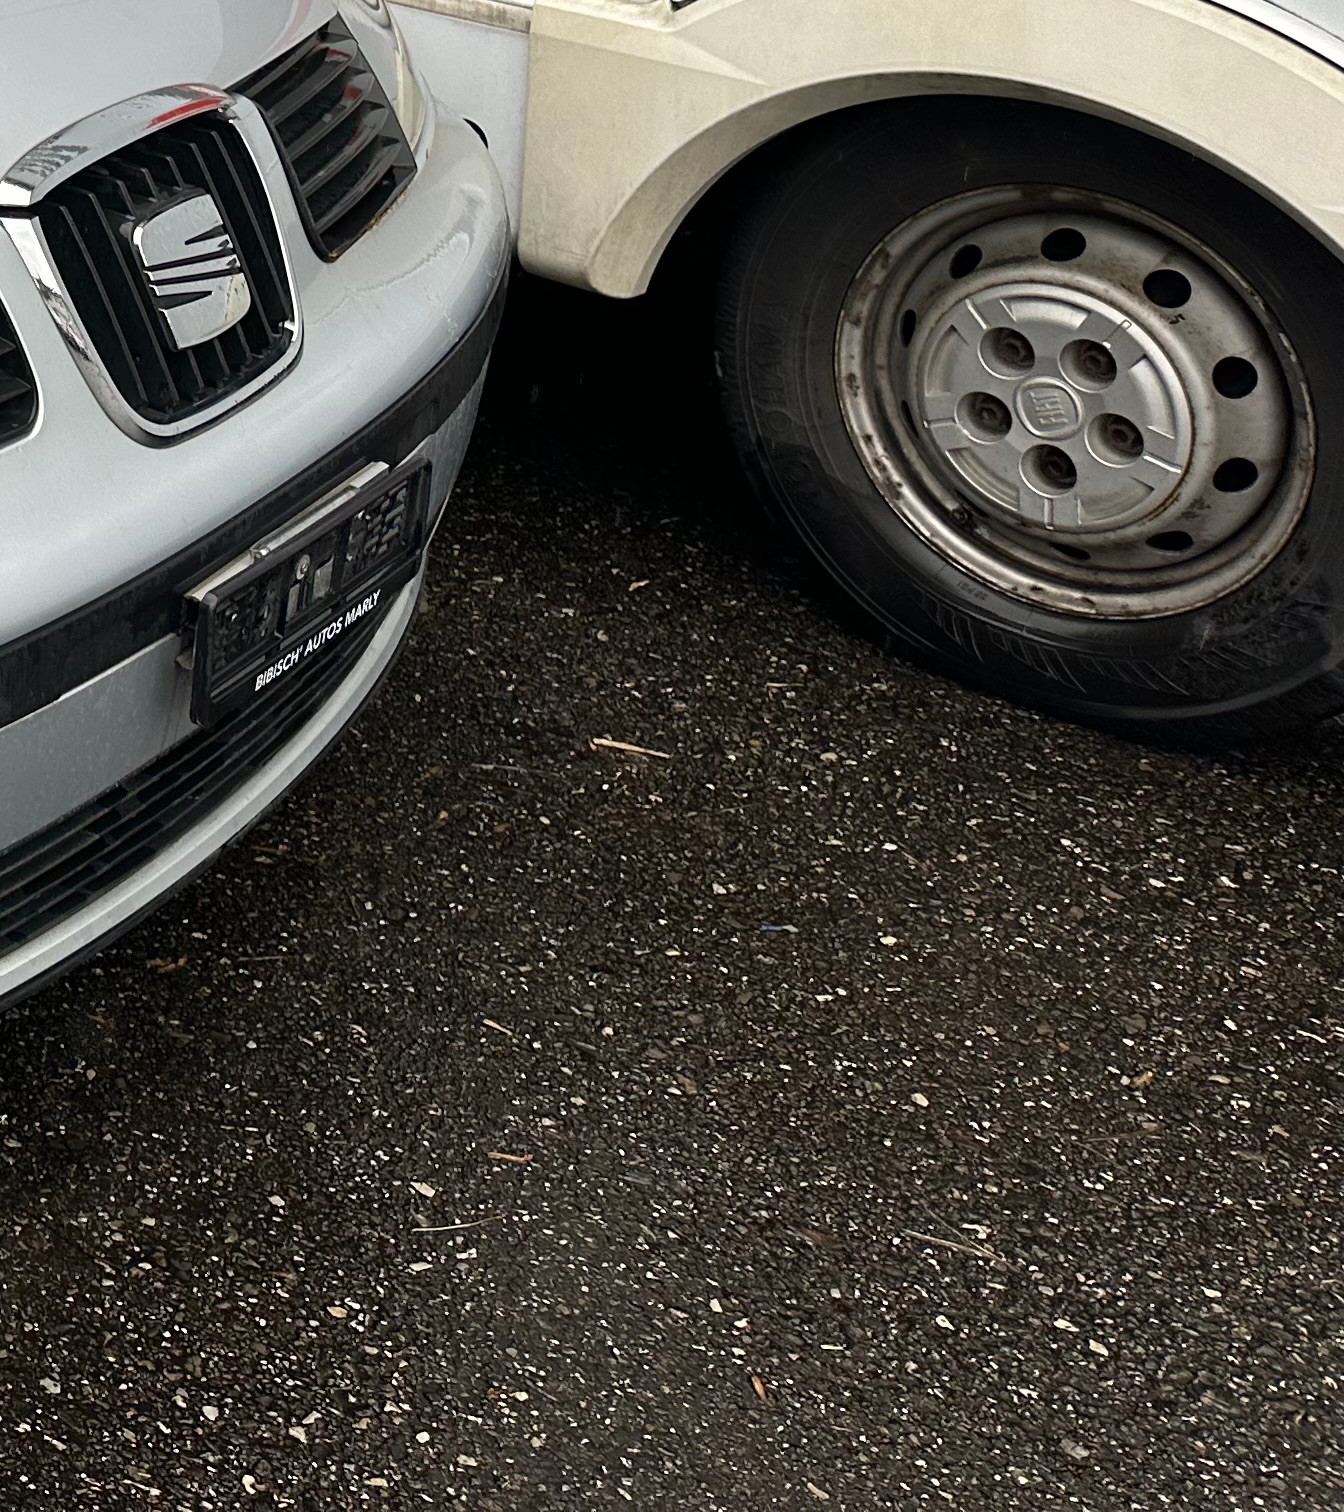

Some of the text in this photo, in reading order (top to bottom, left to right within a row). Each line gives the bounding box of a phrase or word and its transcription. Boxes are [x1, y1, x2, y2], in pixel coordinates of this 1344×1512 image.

[1029, 390, 1070, 426] FIAT
[303, 616, 344, 658] AUTOS
[344, 588, 382, 628] MARLY
